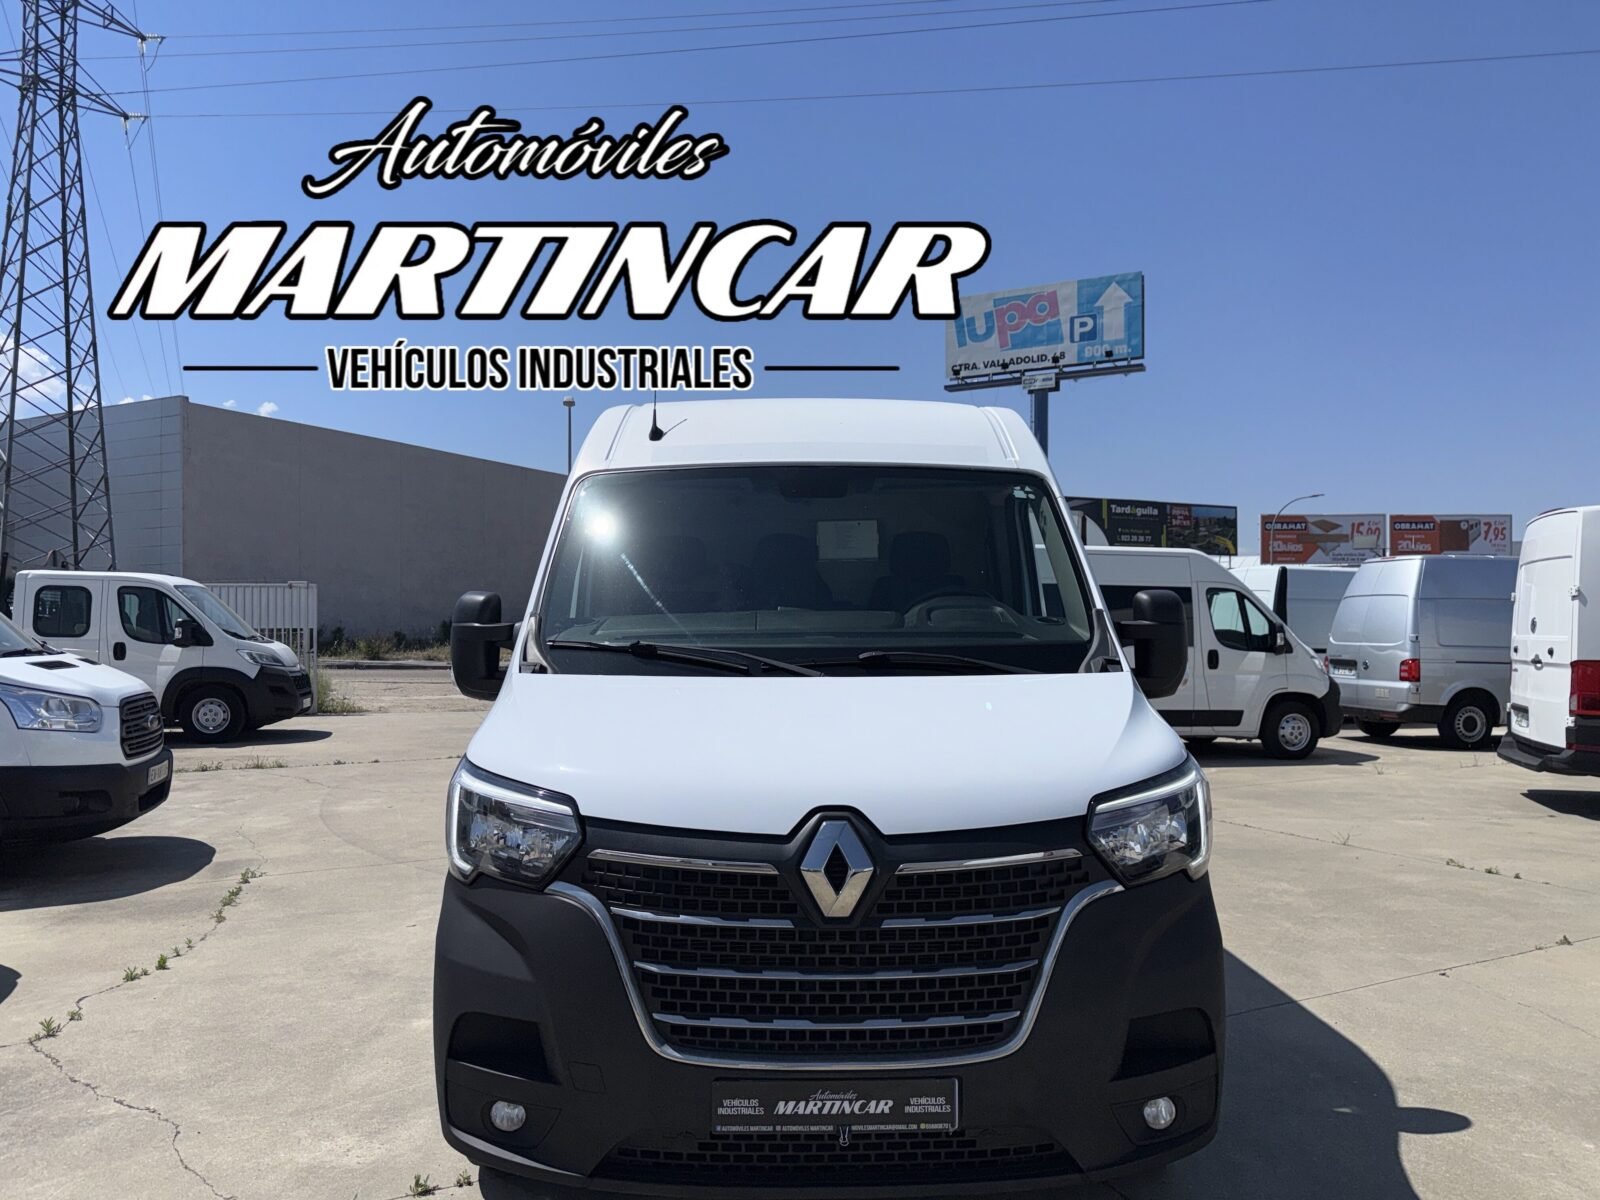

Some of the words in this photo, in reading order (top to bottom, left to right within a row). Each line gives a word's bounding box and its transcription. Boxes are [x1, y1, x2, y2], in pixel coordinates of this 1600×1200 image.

[954, 290, 1060, 350] lupa
[1074, 318, 1094, 342] P
[1394, 522, 1434, 530] OBRAMAT
[1483, 521, 1507, 544] 7,95
[808, 1089, 858, 1101] Automóviles
[909, 1095, 947, 1105] VEHÍCULOS
[722, 1097, 759, 1107] VEHÍCULOS
[774, 1100, 893, 1114] MARTINCAR
[717, 1106, 765, 1115] INDUSTRIALES
[904, 1104, 951, 1114] INDUSTRIALES
